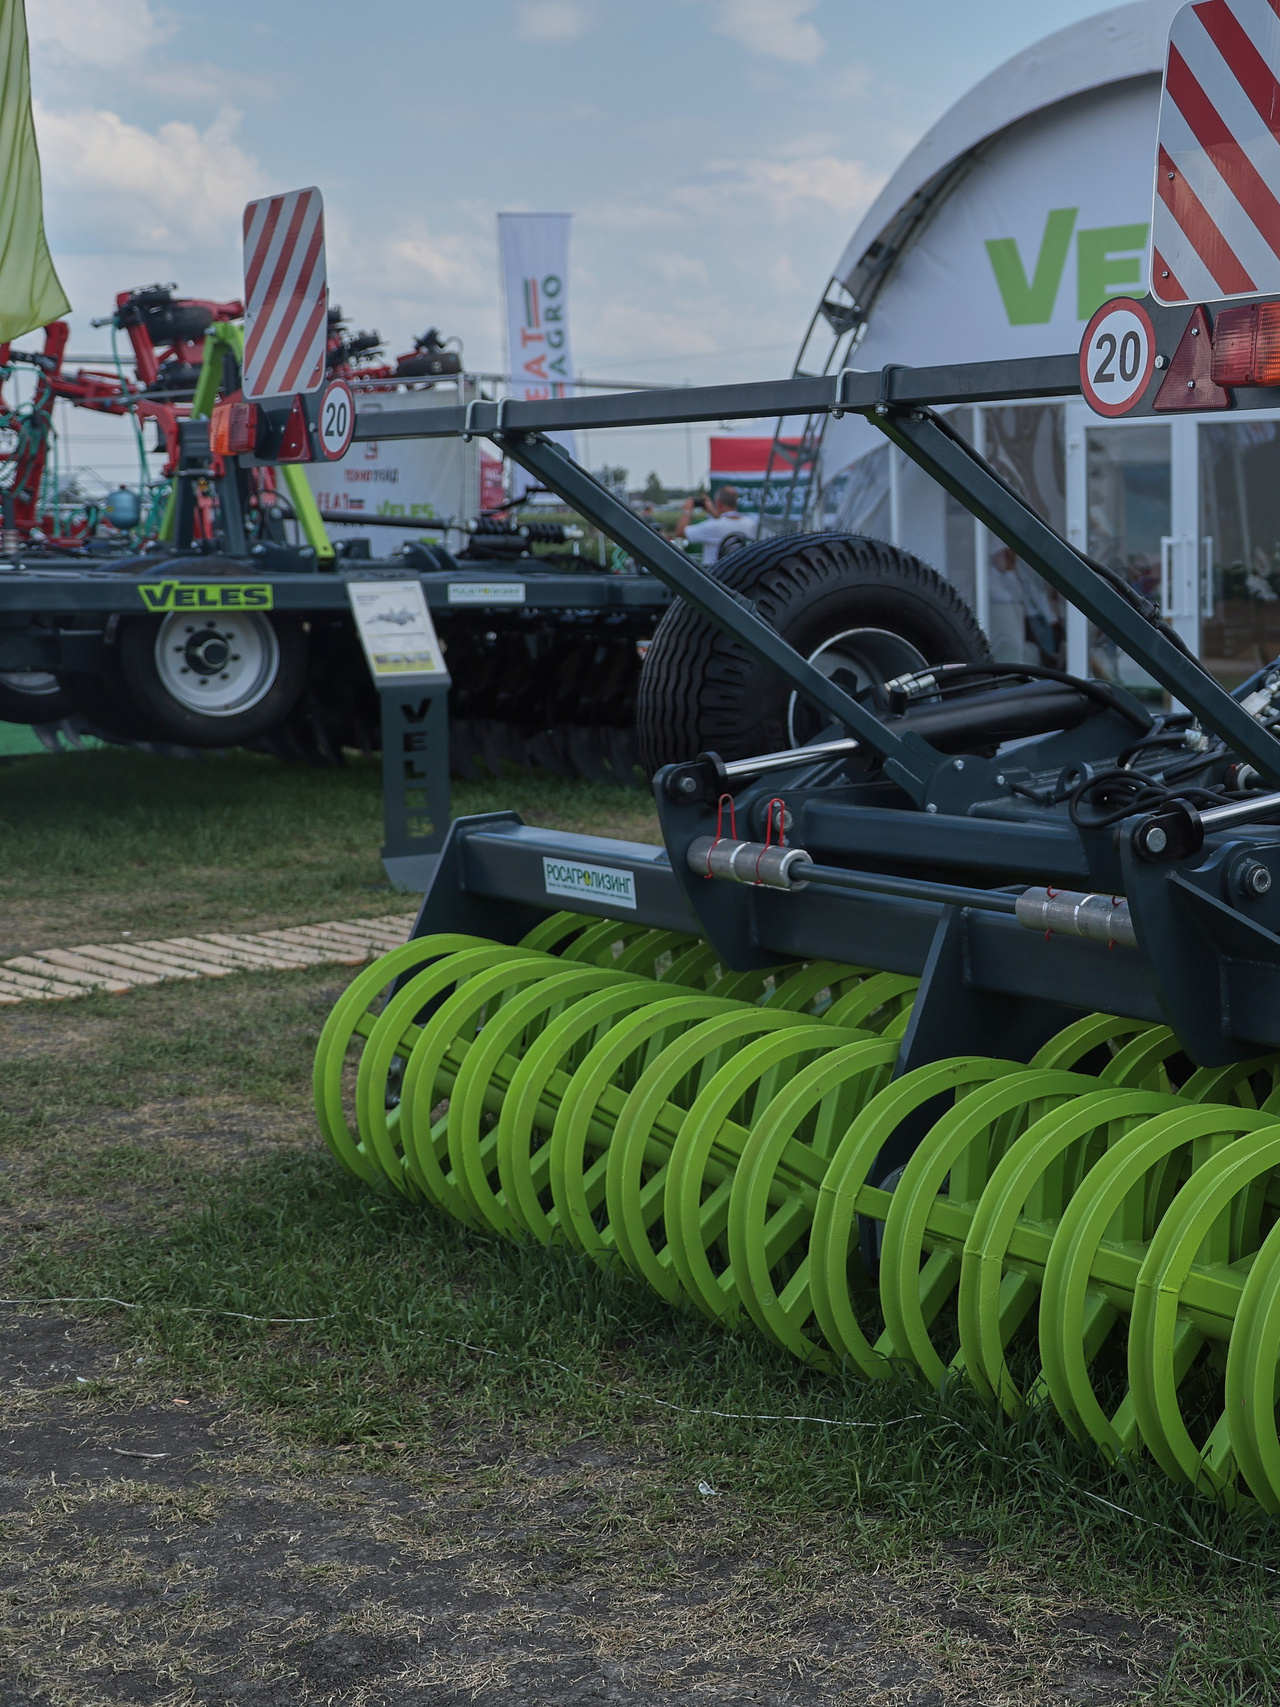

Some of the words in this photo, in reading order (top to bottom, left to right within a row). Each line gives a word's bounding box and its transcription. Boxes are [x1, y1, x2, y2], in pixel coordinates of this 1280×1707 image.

[542, 273, 568, 377] AGRO
[520, 326, 551, 401] EAT
[1092, 329, 1142, 384] 20
[324, 402, 348, 437] 20
[143, 584, 270, 607] VELES
[401, 697, 435, 838] VELES
[546, 863, 632, 894] РОСАГРОЛИЗИНГ
